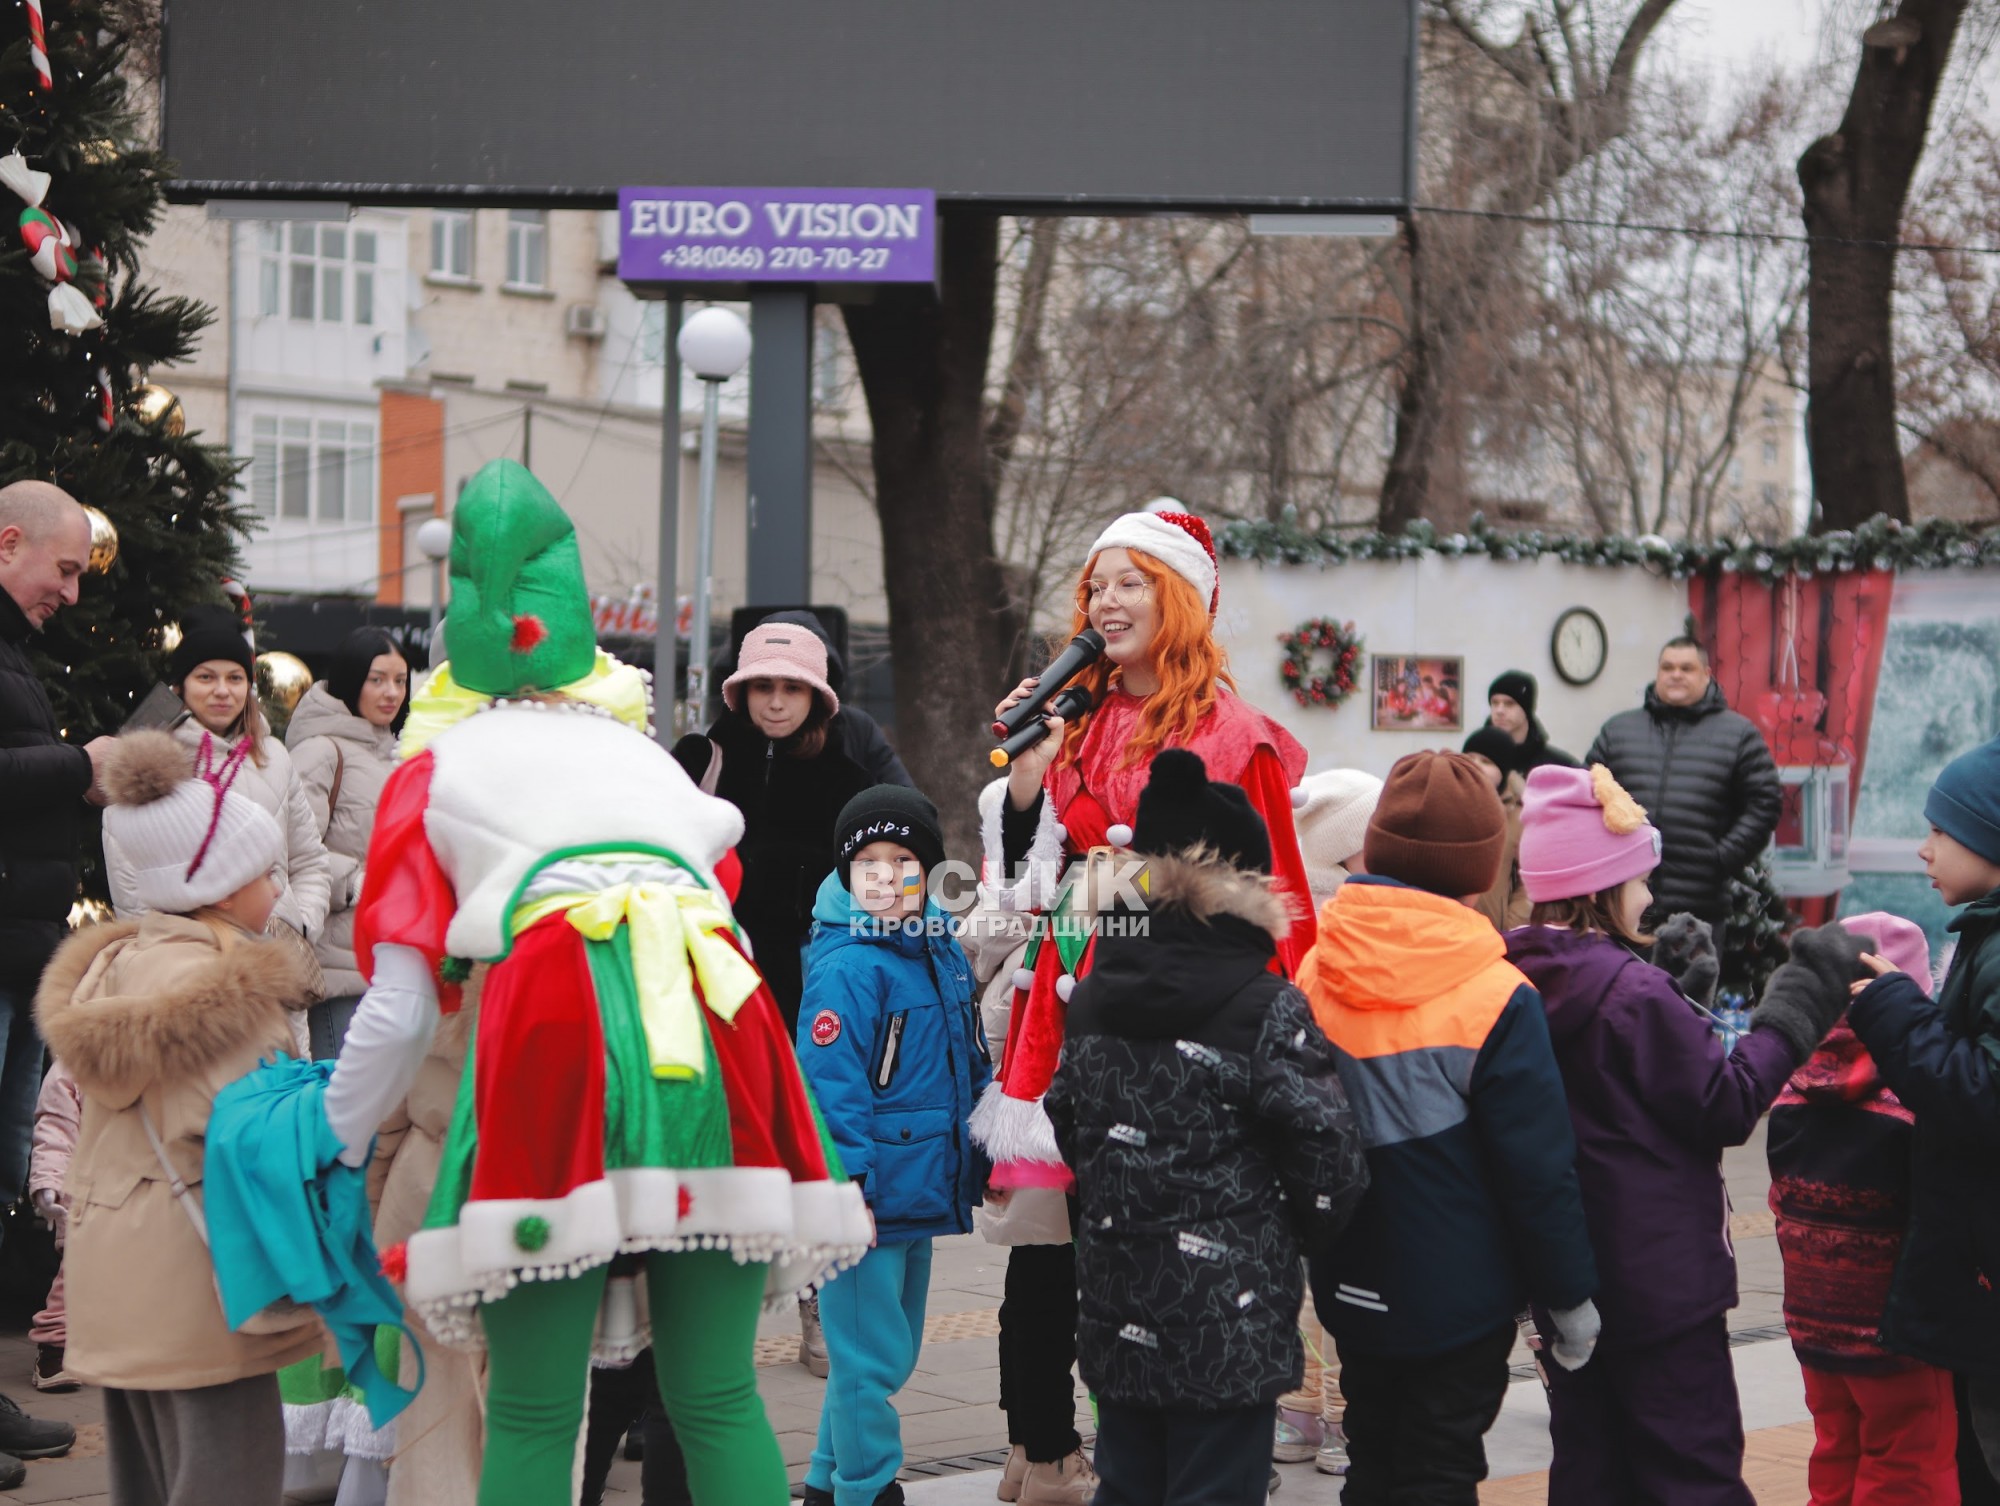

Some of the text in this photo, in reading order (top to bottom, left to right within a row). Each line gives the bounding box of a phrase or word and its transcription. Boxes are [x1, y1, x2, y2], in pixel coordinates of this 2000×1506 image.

[629, 199, 921, 239] EURO VISION
[660, 245, 890, 270] +38(066) 270-70-27
